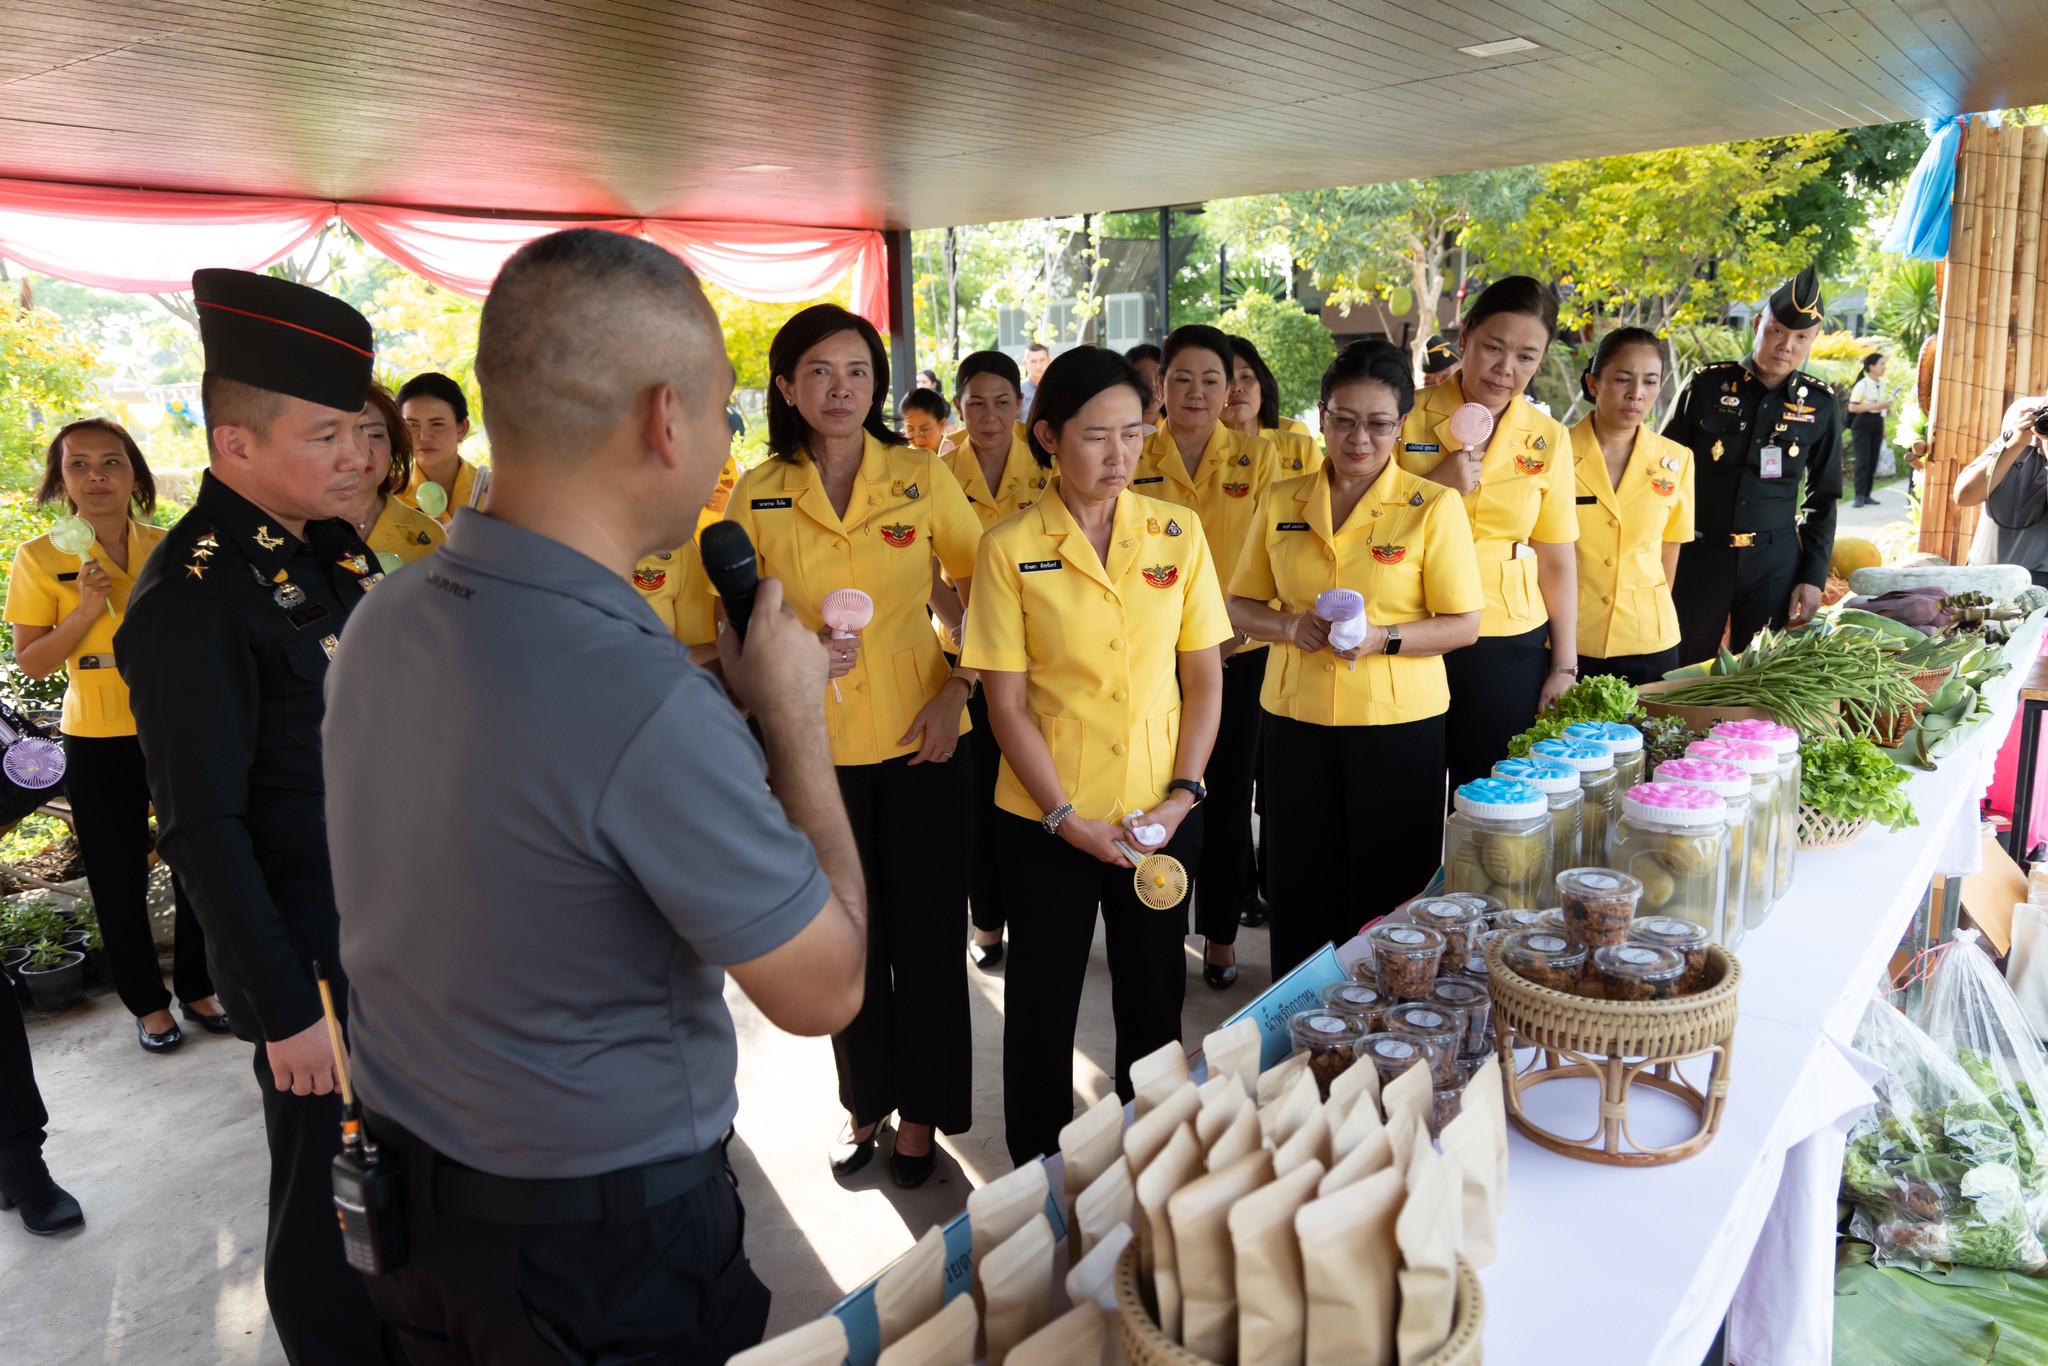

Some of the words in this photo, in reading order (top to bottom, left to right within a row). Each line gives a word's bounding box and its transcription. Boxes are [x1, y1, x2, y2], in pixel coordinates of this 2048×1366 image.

[1262, 986, 1324, 1032] น้ำพริกกากหมู
